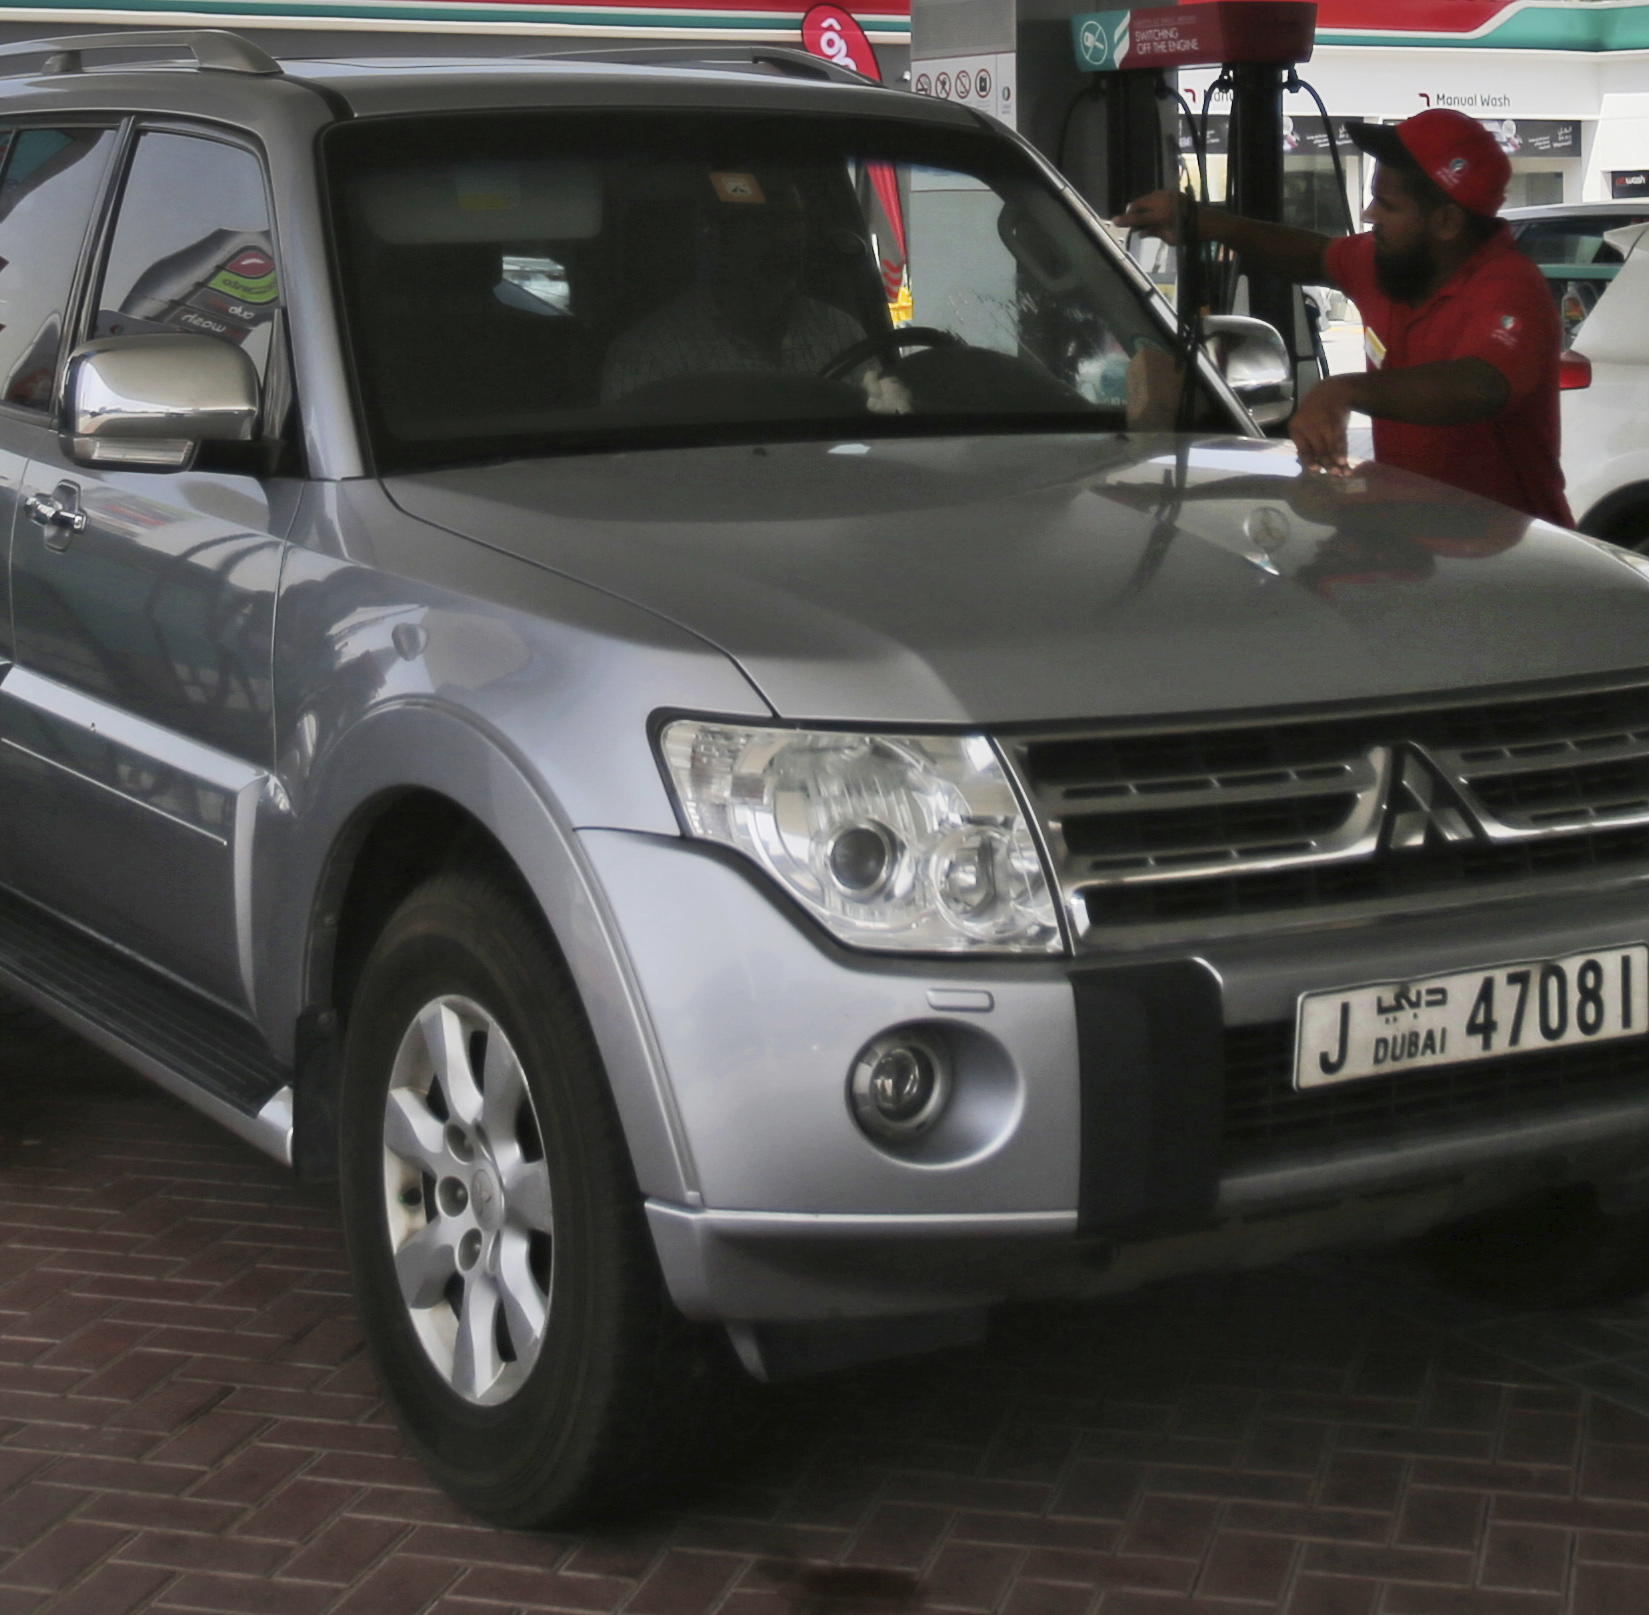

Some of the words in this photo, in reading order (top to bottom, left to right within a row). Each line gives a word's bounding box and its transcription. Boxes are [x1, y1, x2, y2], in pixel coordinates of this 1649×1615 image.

[1135, 27, 1179, 42] SWITCHING
[1136, 43, 1151, 54] OFF
[1153, 41, 1167, 53] THE
[1168, 38, 1199, 52] ENGINE
[1436, 93, 1477, 107] Manual
[1480, 93, 1511, 108] Wash
[1319, 1001, 1350, 1076] J
[1466, 954, 1632, 1052] 47081
[1376, 986, 1448, 1025] دبي
[1373, 1027, 1448, 1066] DUBAI
